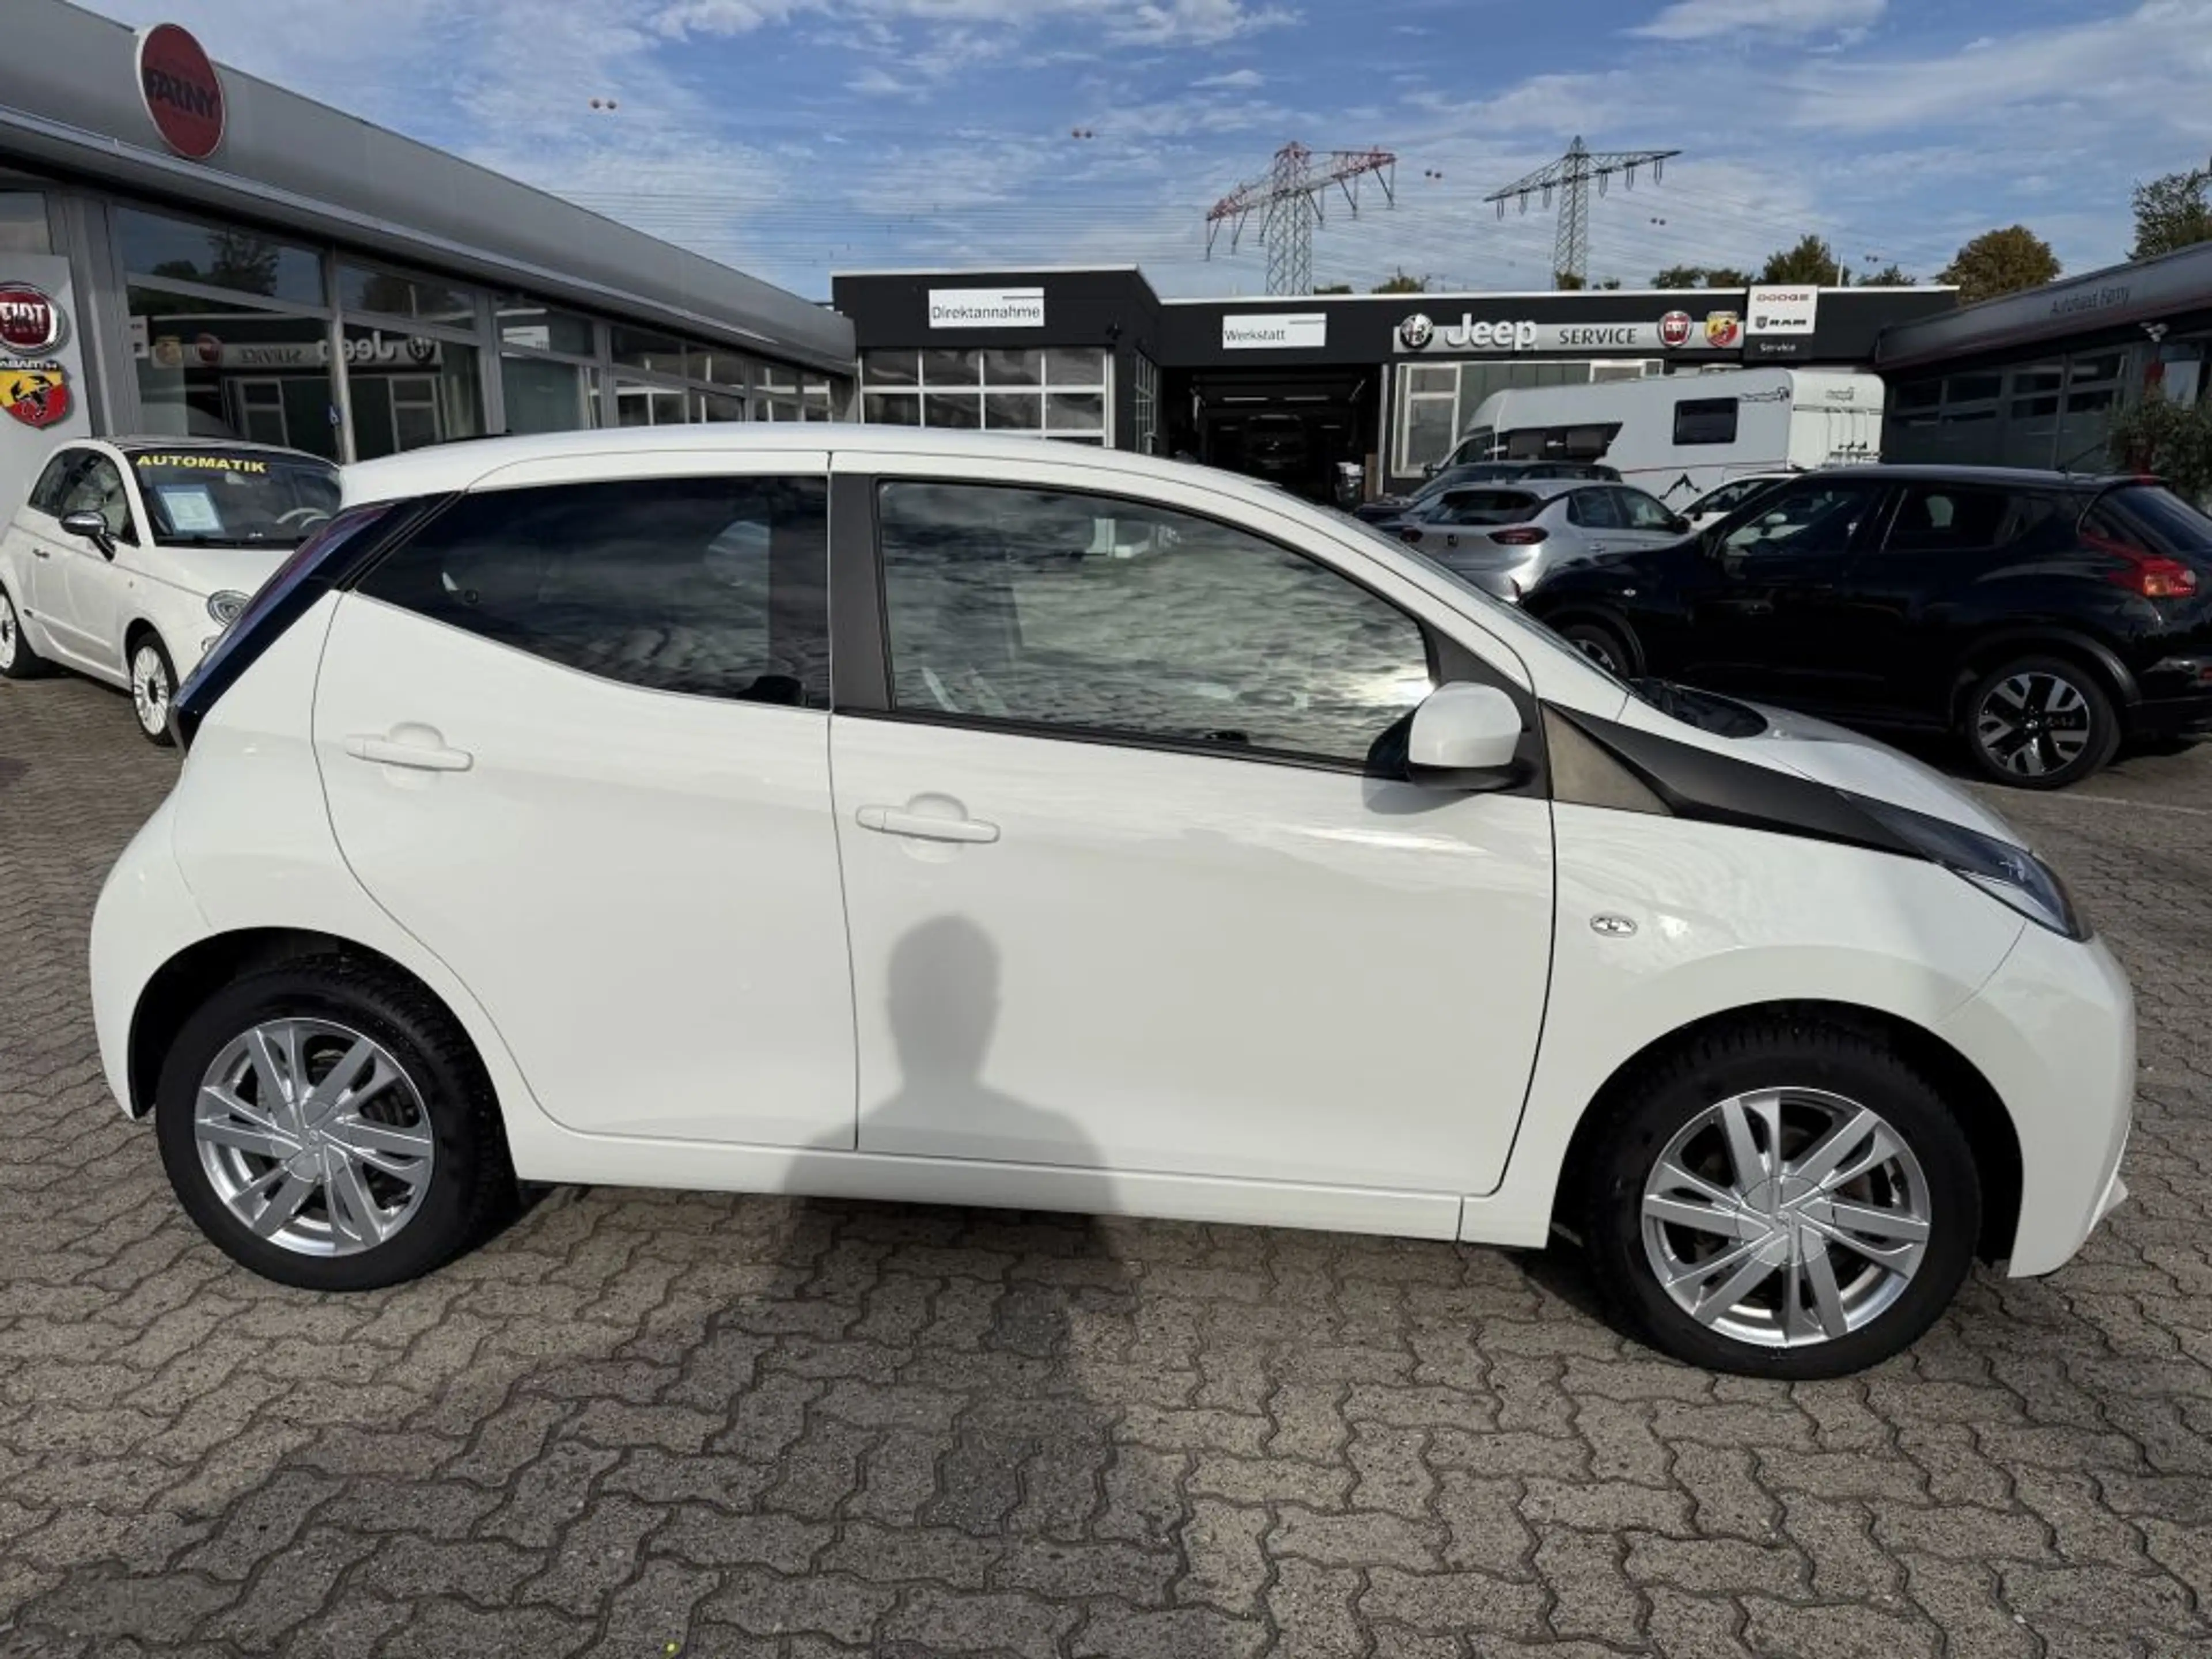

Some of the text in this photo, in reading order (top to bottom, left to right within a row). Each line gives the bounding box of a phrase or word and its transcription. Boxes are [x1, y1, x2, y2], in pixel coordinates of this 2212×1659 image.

[933, 304, 1040, 319] Direktannahme
[1224, 329, 1286, 341] Werkstatt
[1446, 313, 1637, 351] Jeep SERVICE
[1760, 343, 1796, 352] Service
[137, 456, 267, 473] AUTOMATIK
